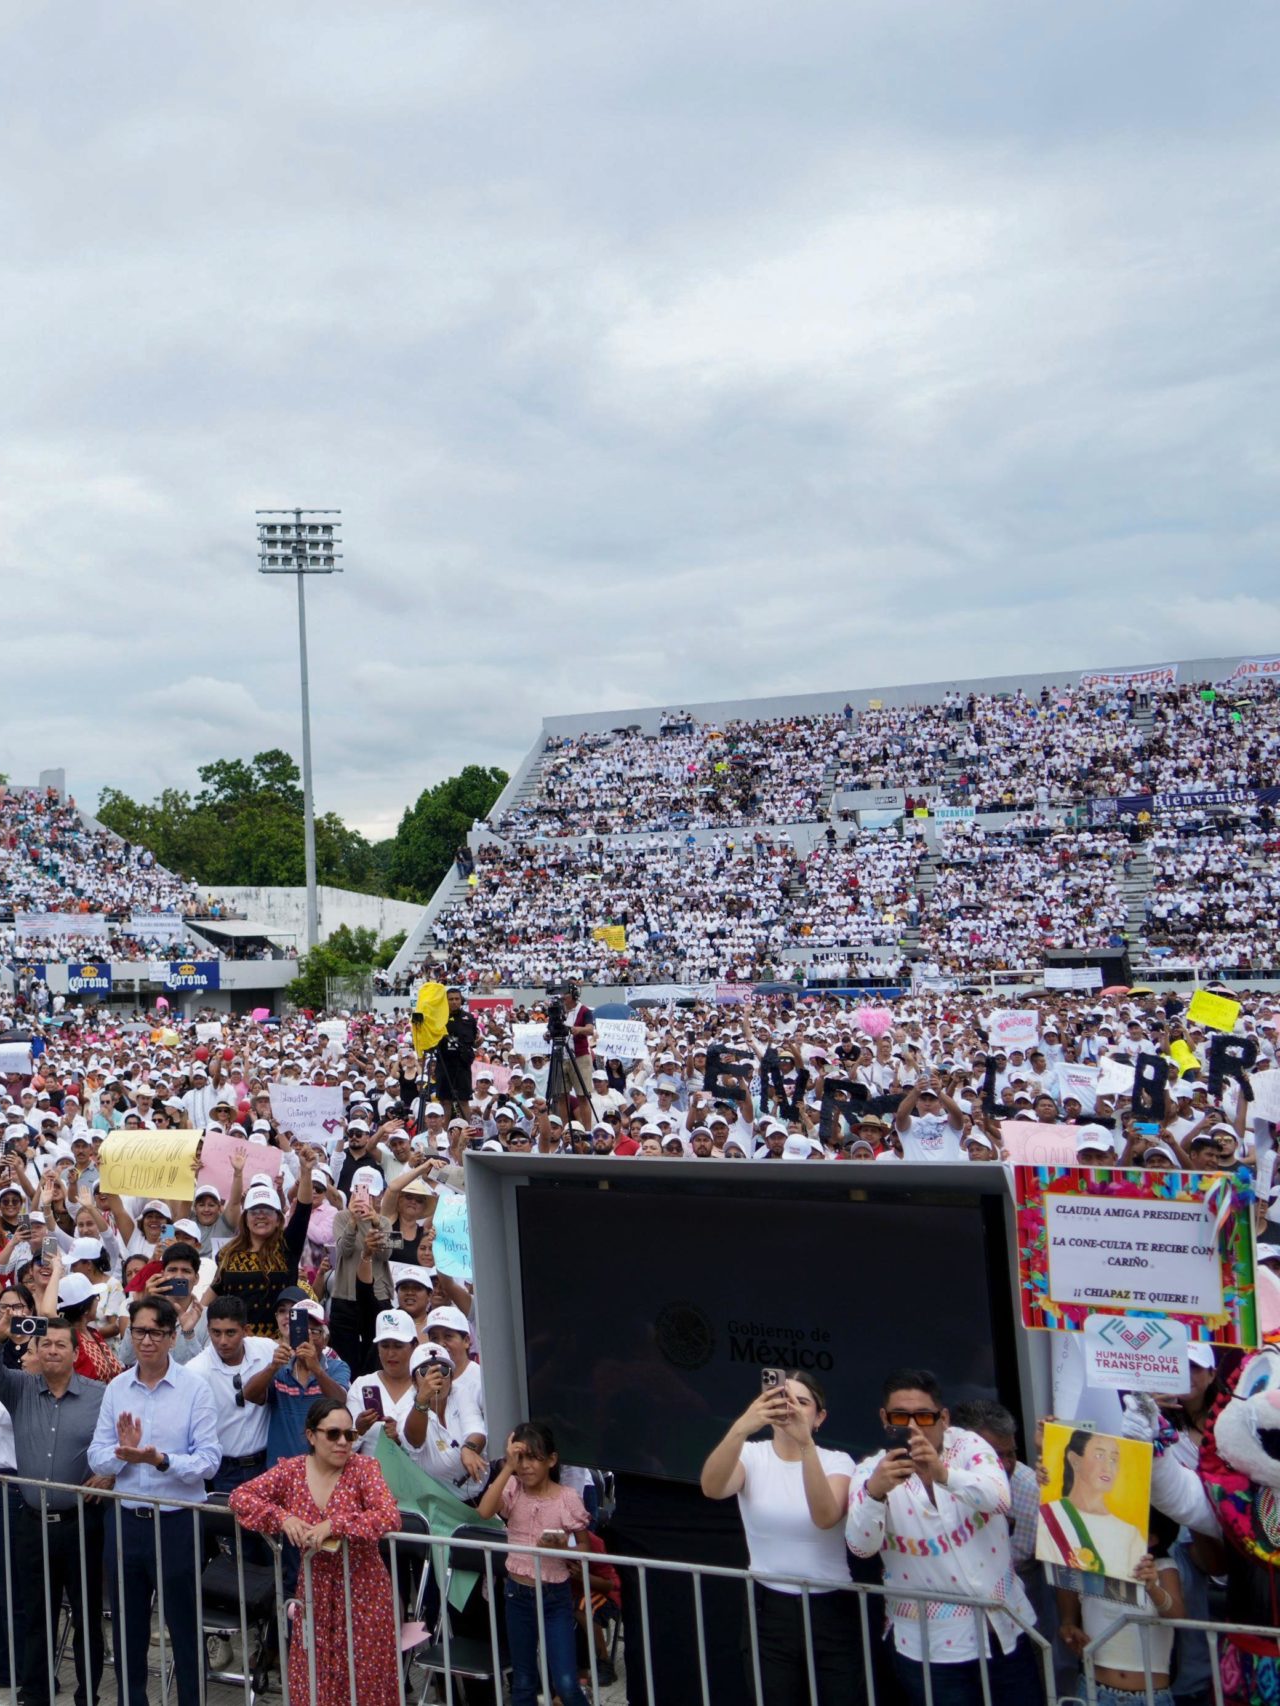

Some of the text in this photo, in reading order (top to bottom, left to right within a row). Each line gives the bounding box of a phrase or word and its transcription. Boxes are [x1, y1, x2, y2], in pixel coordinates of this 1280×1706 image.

[1153, 788, 1256, 807] Bienvenida
[69, 976, 109, 993] Corona
[166, 973, 208, 988] Corona
[1056, 1205, 1101, 1216] CLAUDIA
[1104, 1208, 1140, 1219] AMIGA
[1052, 1237, 1215, 1256] LA CONE-CULTA TE RECIBE CON
[1107, 1256, 1149, 1268] CARIÑO
[1084, 1288, 1131, 1299] CHIAPAZ
[1133, 1290, 1146, 1300] TE
[1148, 1291, 1189, 1304] QUIERE
[727, 1320, 831, 1342] Gobierno de
[729, 1336, 834, 1371] México
[1095, 1351, 1179, 1364] HUMANISMO QUE
[1095, 1359, 1180, 1374] TRANSFORMA
